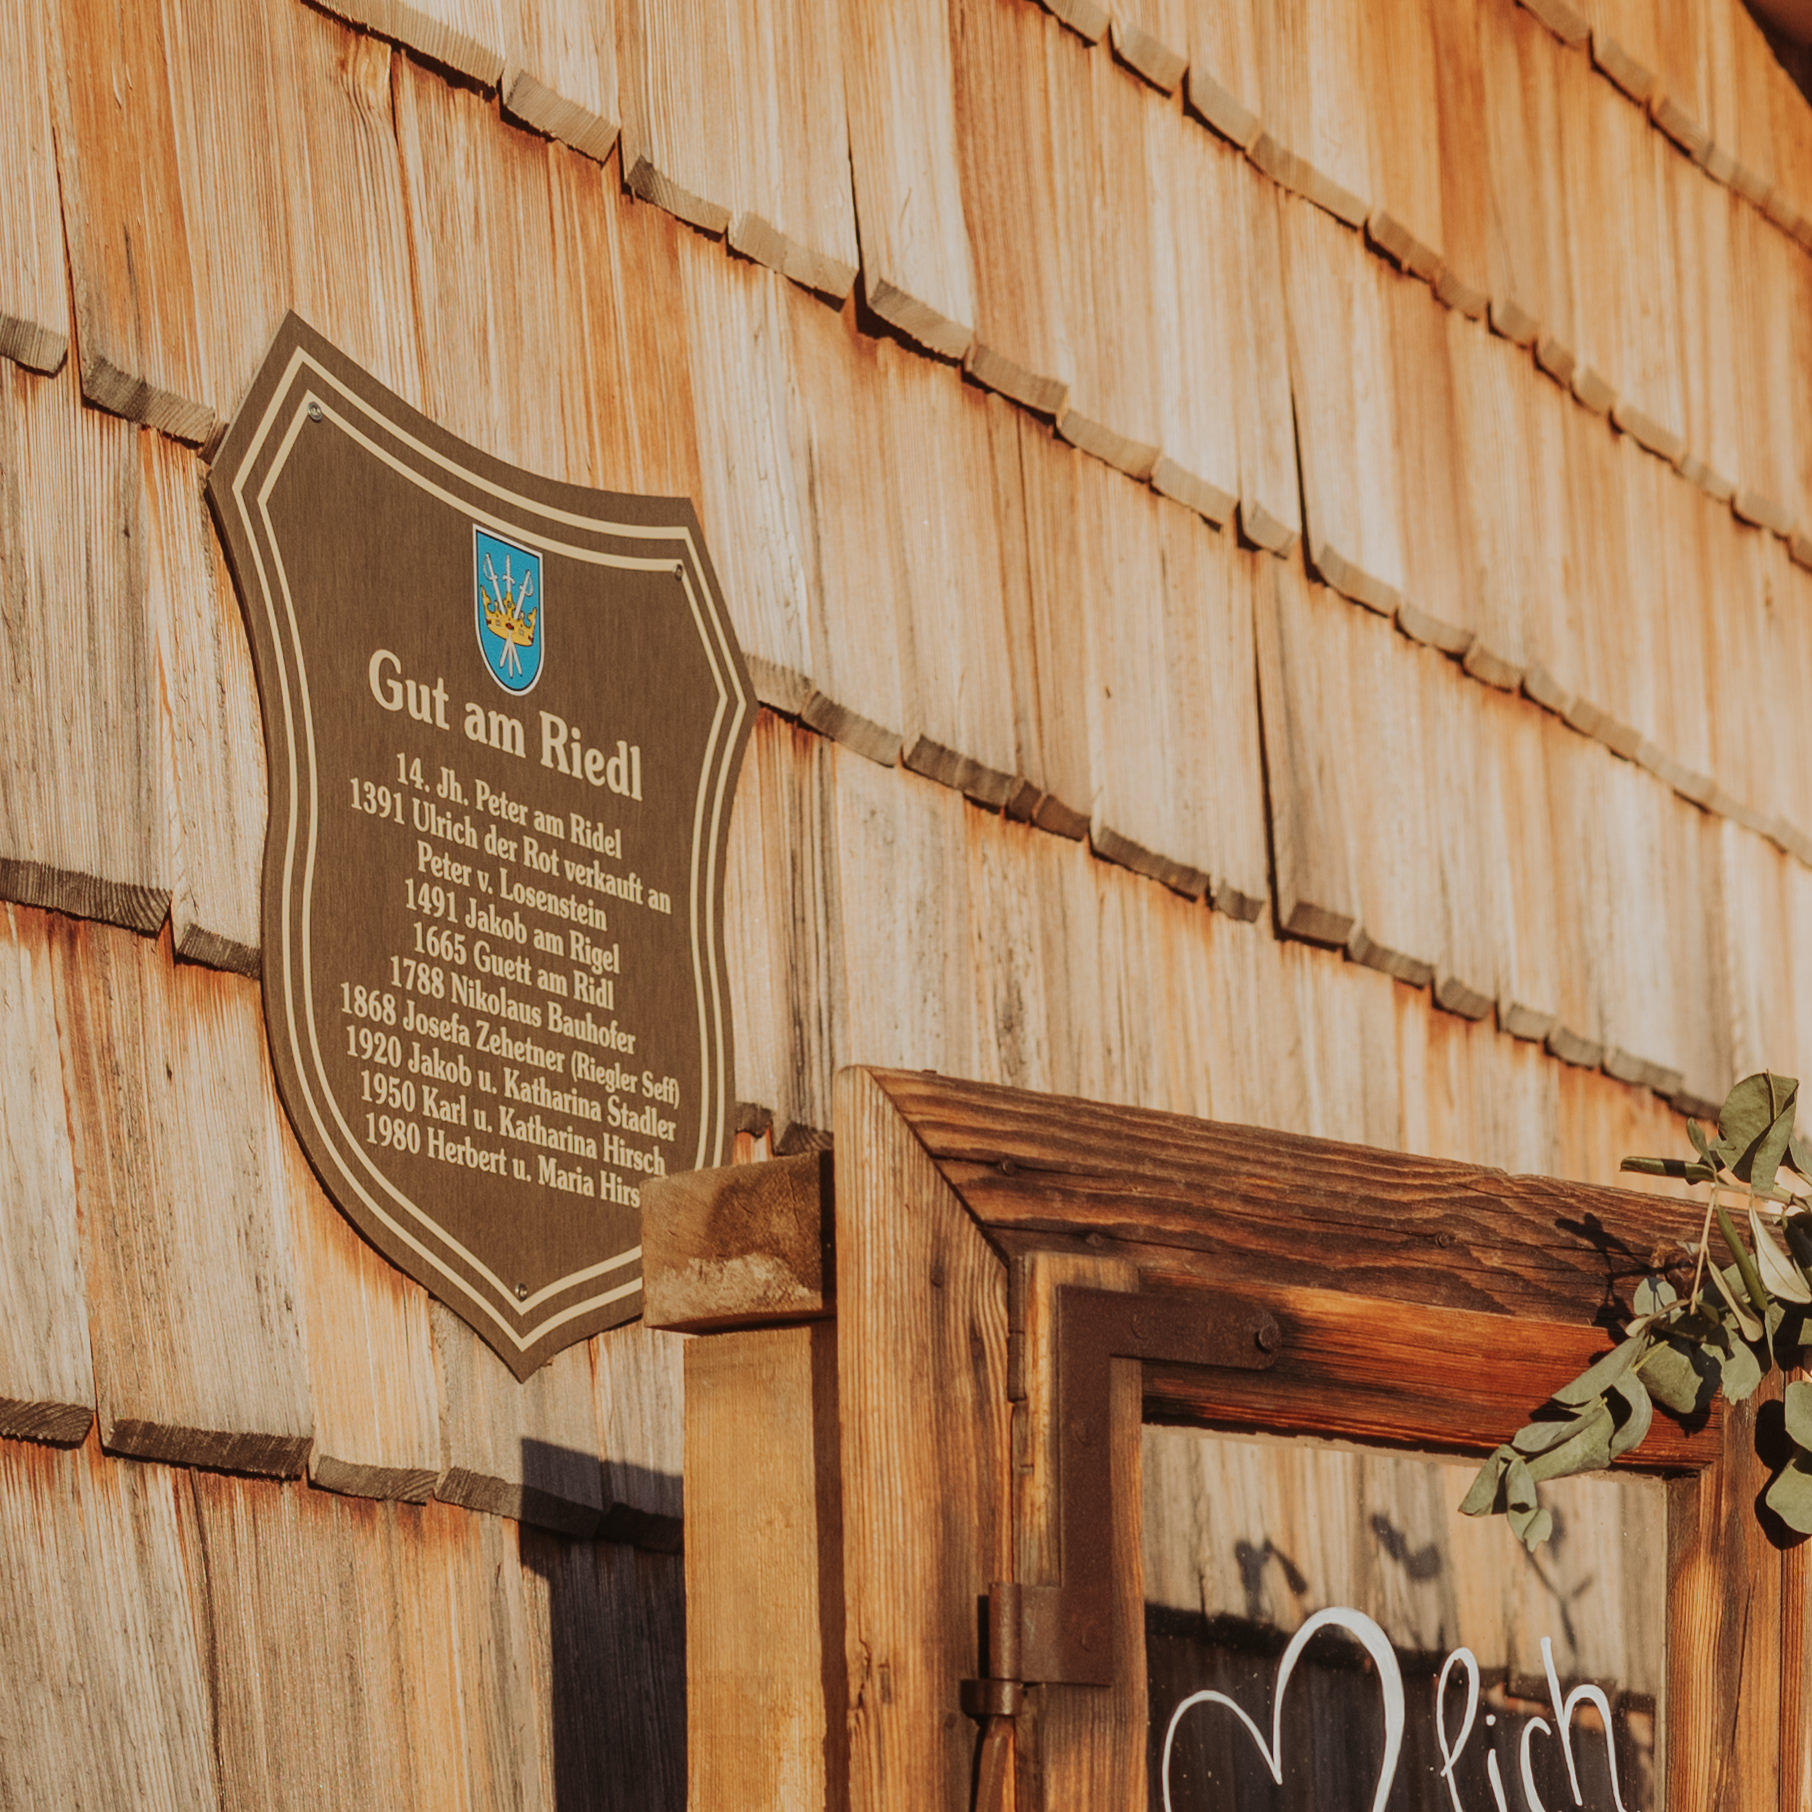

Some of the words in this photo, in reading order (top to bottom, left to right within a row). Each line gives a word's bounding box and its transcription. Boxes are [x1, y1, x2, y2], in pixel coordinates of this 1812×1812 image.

[368, 649, 450, 731] Gut
[464, 702, 527, 759] am
[539, 710, 643, 802] Riedl
[349, 777, 405, 825] 1391
[411, 797, 479, 850] Ulrich
[484, 824, 518, 863] der
[522, 835, 560, 877] Rot
[563, 859, 644, 905] verkauft
[647, 888, 672, 915] an
[396, 752, 430, 793] 14.
[436, 766, 469, 806] Jh.
[474, 778, 529, 826] Peter
[533, 810, 565, 840] am
[569, 812, 622, 860] Ridel
[404, 878, 458, 924] 1491
[464, 897, 528, 945] Jakob
[533, 928, 565, 957] am
[569, 929, 620, 975] Rigel
[417, 839, 472, 887] Peter
[476, 869, 493, 895] v.
[499, 867, 608, 932] Losenstein
[390, 955, 445, 999] 1788
[450, 971, 542, 1028] Nikolaus
[547, 1000, 636, 1055] Bauhofer
[413, 921, 467, 965] 1665
[473, 940, 532, 986] Guett
[537, 968, 569, 997] am
[573, 969, 614, 1011] Ridl
[340, 981, 397, 1026] 1868
[402, 999, 471, 1048] Josefa
[476, 1019, 566, 1073] Zehetner
[571, 1050, 638, 1094] (Riegler
[641, 1070, 680, 1110] Seff)
[346, 1024, 402, 1068] 1920
[407, 1041, 472, 1087] Jakob
[477, 1070, 498, 1095] u.
[503, 1066, 602, 1122] Katharina
[607, 1094, 677, 1142] Stadler
[360, 1069, 416, 1113] 1950
[421, 1084, 467, 1127] Karl
[473, 1108, 493, 1133] u.
[498, 1105, 598, 1160] Katharina
[602, 1132, 666, 1176] Hirsch
[365, 1112, 421, 1154] 1980
[427, 1126, 508, 1176] Herbert
[511, 1158, 532, 1182] u.
[537, 1154, 595, 1197] Maria
